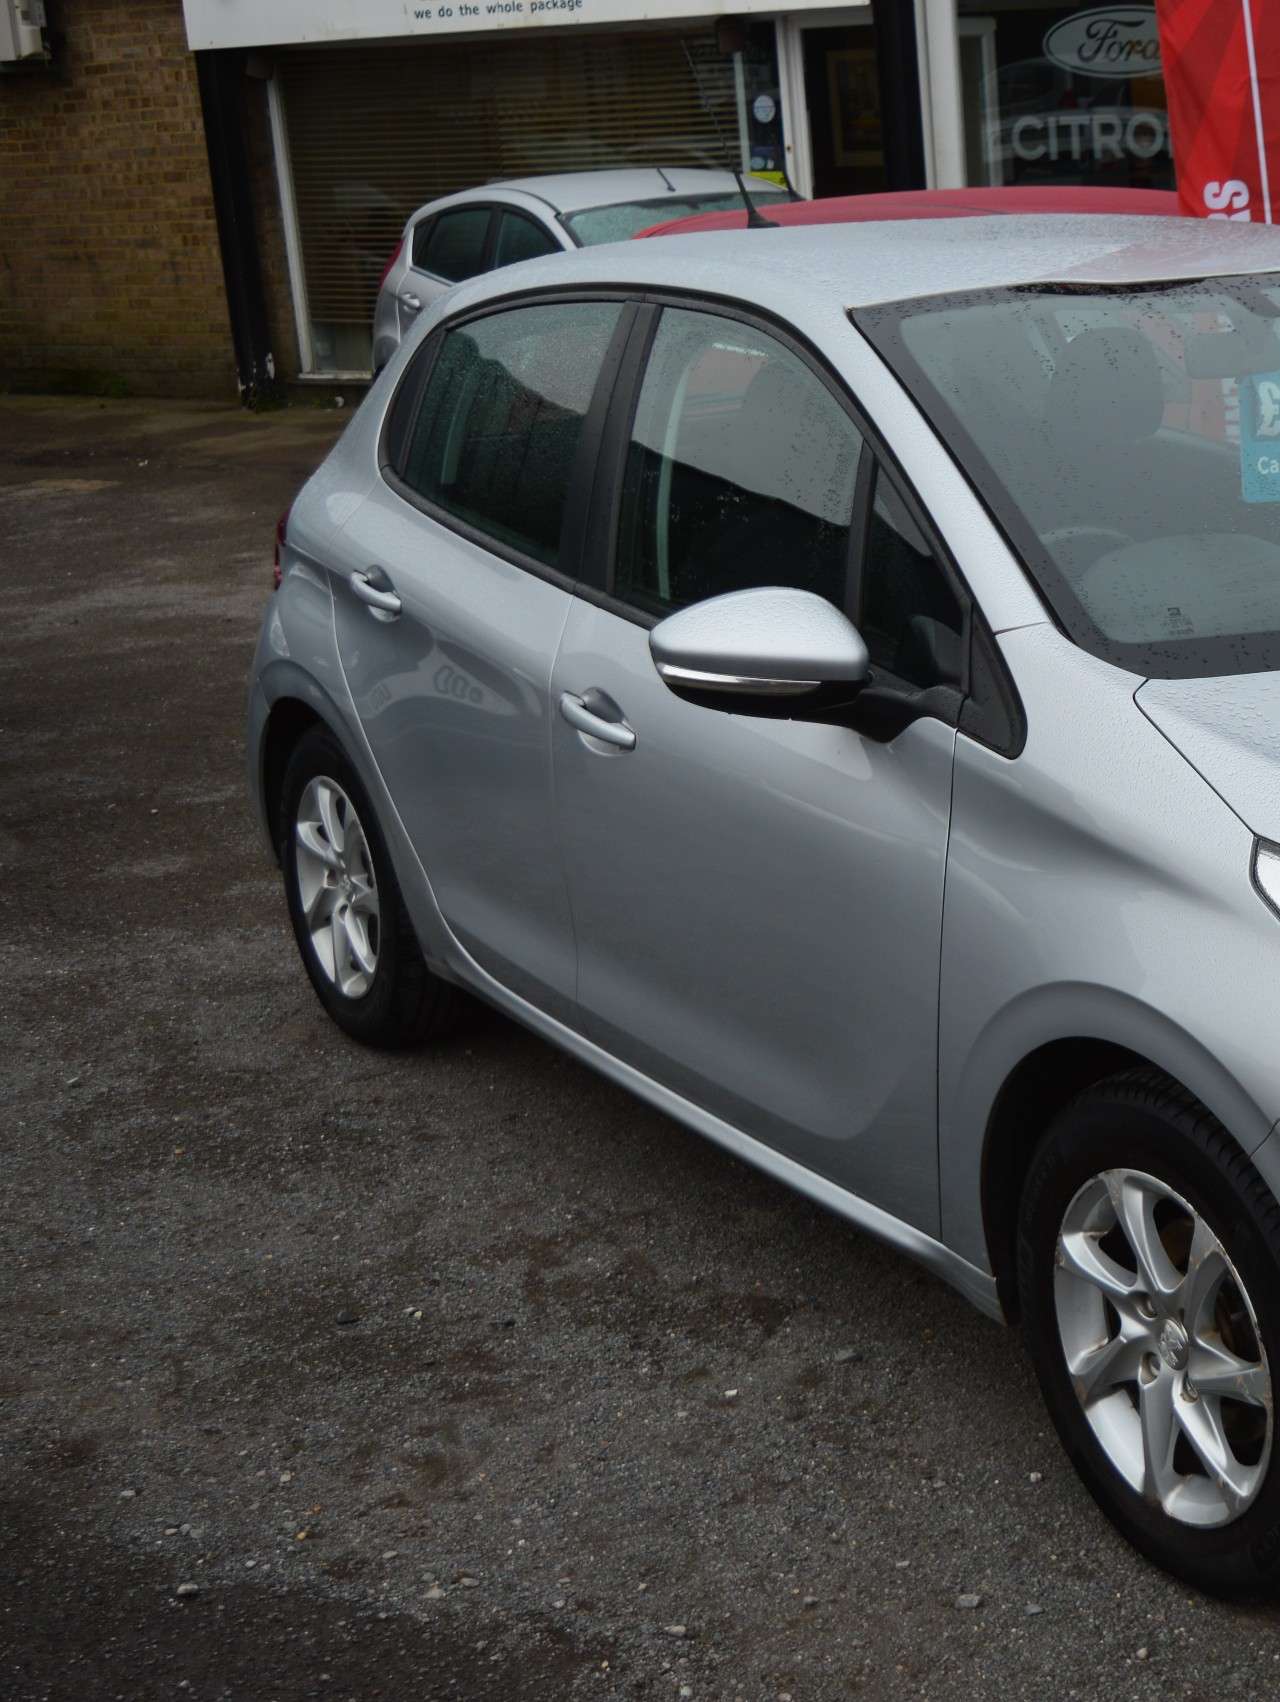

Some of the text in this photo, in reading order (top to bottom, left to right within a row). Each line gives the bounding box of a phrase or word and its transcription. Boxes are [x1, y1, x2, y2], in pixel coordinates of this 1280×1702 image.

[413, 0, 583, 20] we do the whole package
